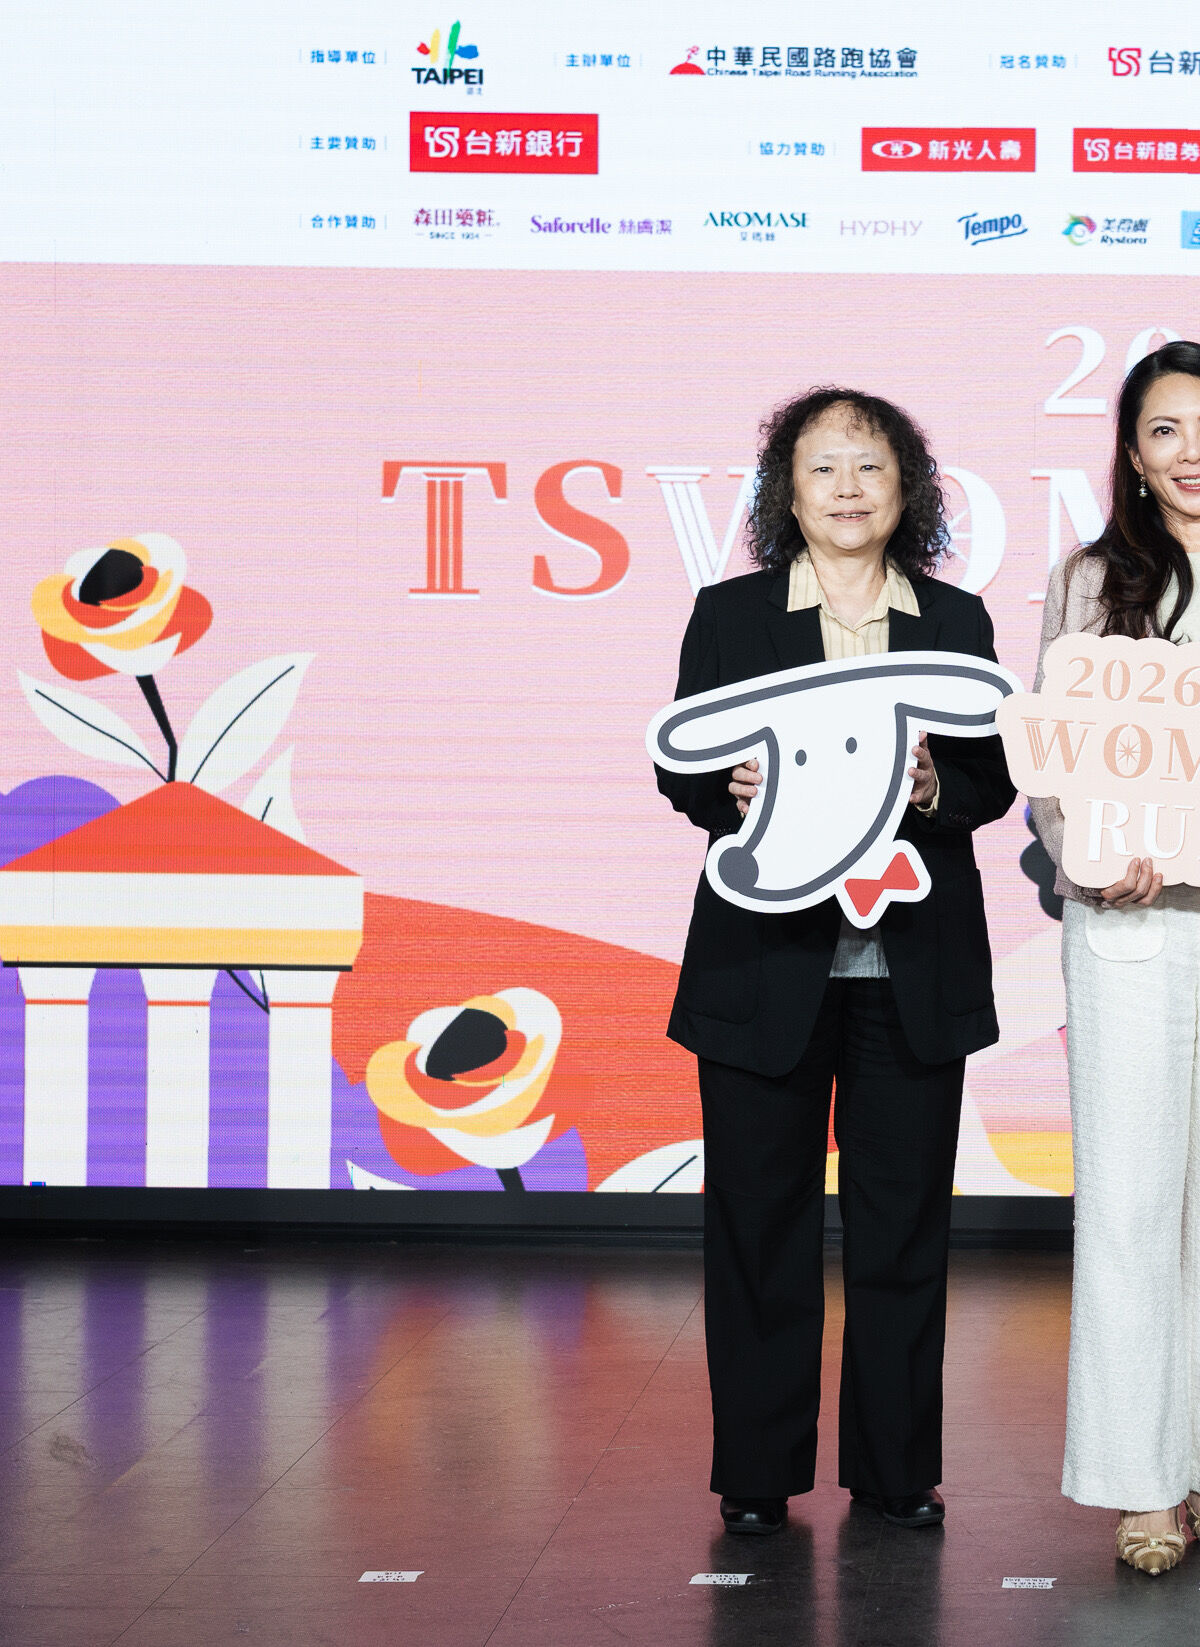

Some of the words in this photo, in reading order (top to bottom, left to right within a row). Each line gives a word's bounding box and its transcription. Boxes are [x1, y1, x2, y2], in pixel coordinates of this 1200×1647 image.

[706, 45, 918, 69] 中華民國路跑協會
[411, 67, 484, 85] TAIPEI
[706, 67, 748, 78] Chinese
[752, 67, 781, 79] Taipei
[785, 67, 811, 78] Road
[815, 67, 857, 79] Running
[860, 67, 918, 78] Association
[464, 129, 584, 158] 台新銀行
[759, 141, 825, 156] 協力贊助
[927, 139, 1022, 161] 新光人壽
[1113, 141, 1200, 162] 台新證券
[530, 215, 612, 234] Saforelle
[703, 211, 807, 228] AROMASE
[840, 220, 923, 236] HYPHY
[957, 212, 1025, 241] Tempo
